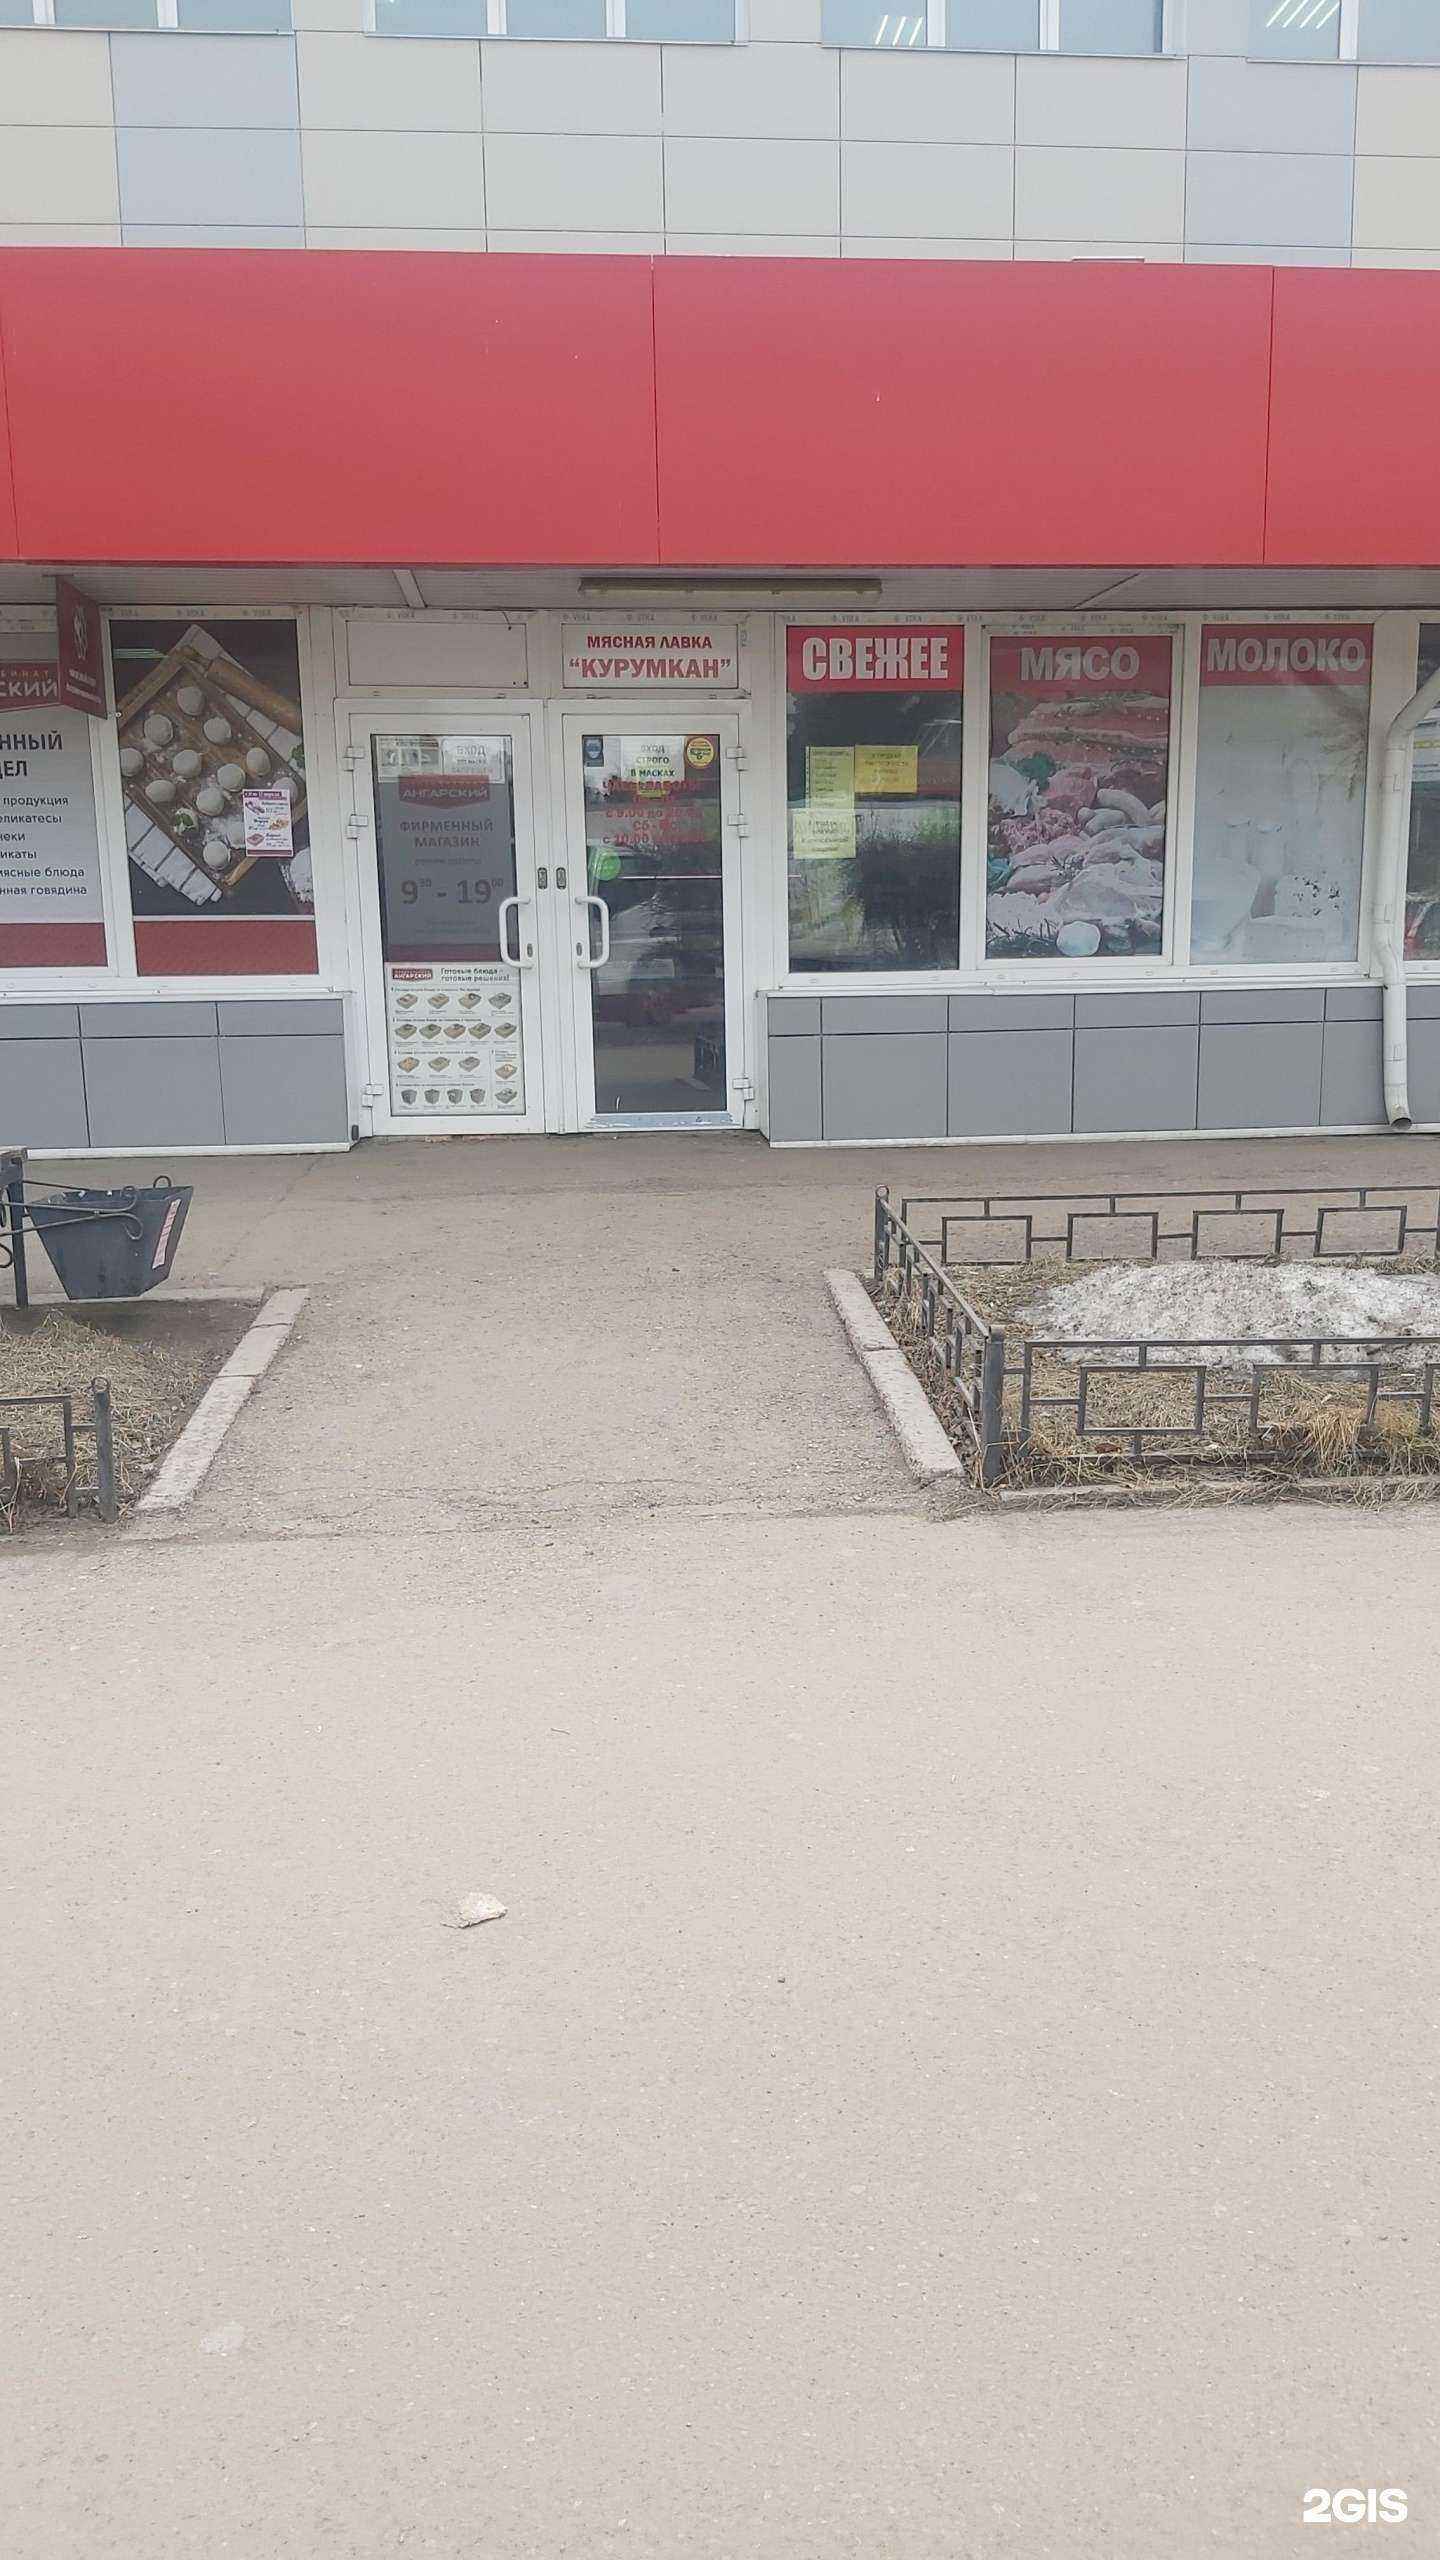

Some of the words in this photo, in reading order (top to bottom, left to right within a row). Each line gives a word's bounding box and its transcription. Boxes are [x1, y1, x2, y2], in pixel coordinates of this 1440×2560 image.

[587, 636, 656, 649] МЯСНАЯ
[660, 636, 713, 649] ЛАВКА
[802, 637, 948, 680] СВЕЖЕЕ
[1207, 638, 1367, 673] МОЛОКО
[1020, 647, 1140, 681] МЯСО
[635, 756, 670, 764] СТРОГО
[639, 769, 676, 777] МАСКАХ
[401, 785, 489, 799] АНГАРСКИЙ
[3, 797, 69, 807] продукция
[0, 815, 62, 823] ликатесы
[400, 818, 494, 832] ФИРМЕННЫЙ
[415, 836, 481, 848] МАГАЗИН
[0, 868, 41, 877] ясные
[45, 867, 85, 878] блюда
[31, 886, 88, 896] говядина
